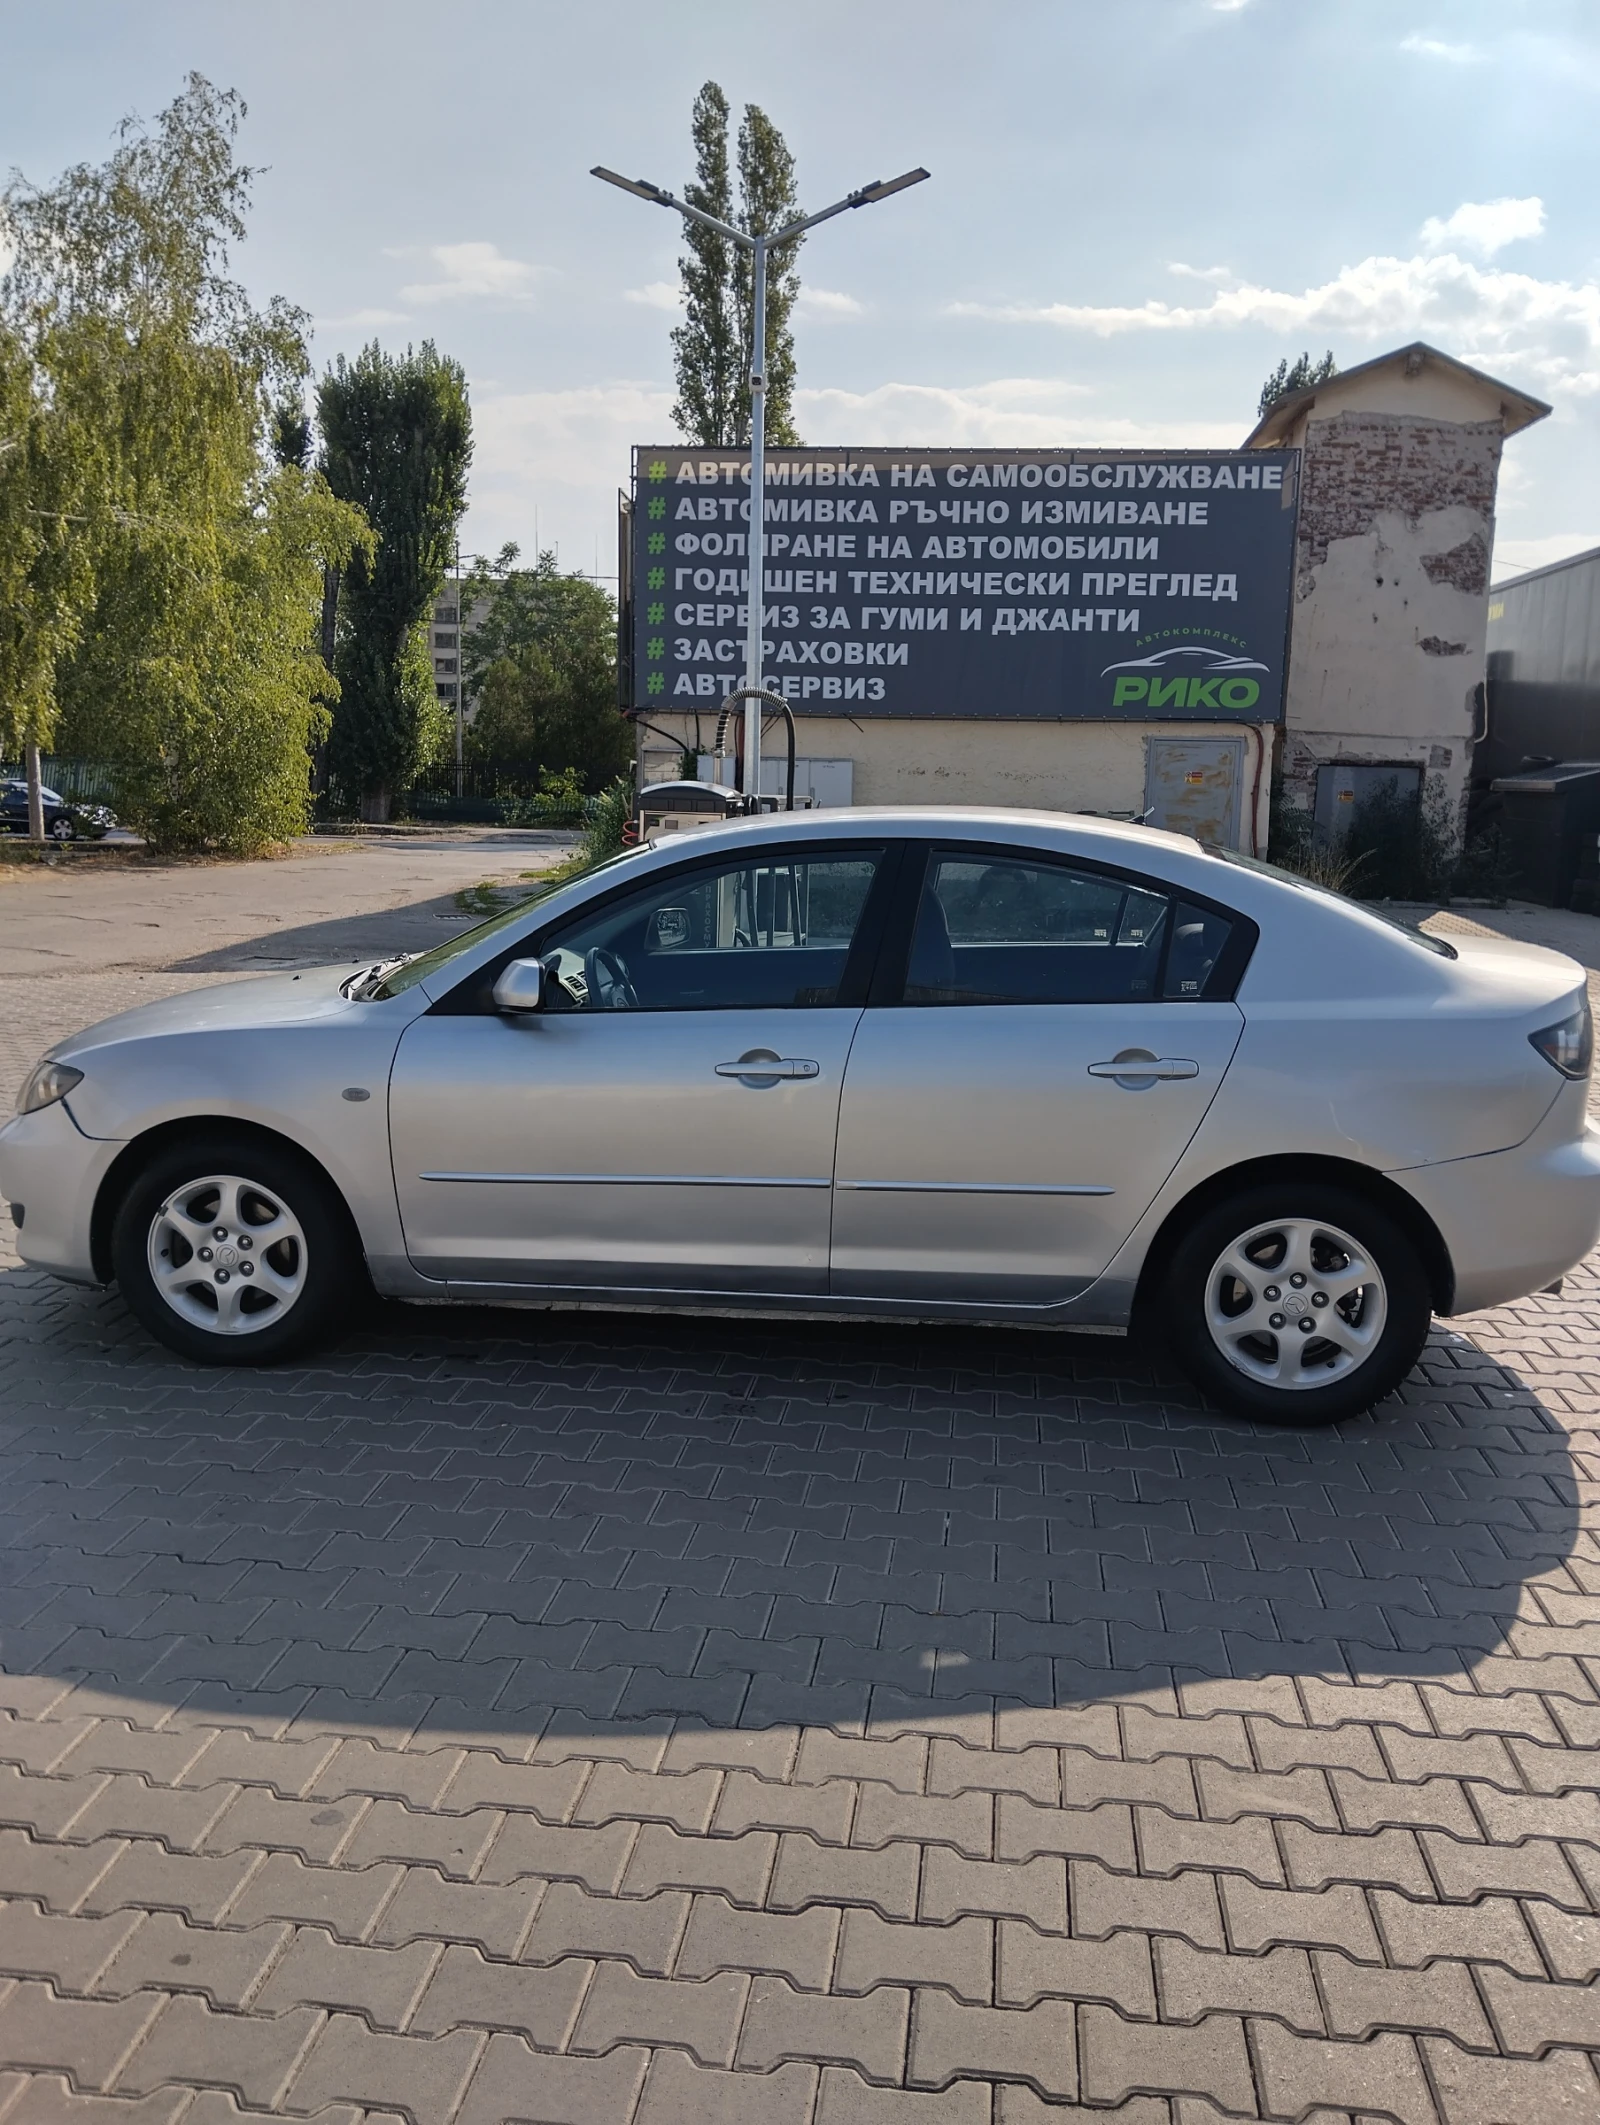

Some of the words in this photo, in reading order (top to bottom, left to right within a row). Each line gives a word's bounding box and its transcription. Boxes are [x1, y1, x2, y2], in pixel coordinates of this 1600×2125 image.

[891, 464, 936, 486] НА
[947, 464, 1282, 489] САМООБСЛУЖВАНЕ
[890, 501, 1009, 523] РЪЧНО
[1022, 501, 1208, 524] ИЗМИВАНЕ
[868, 536, 912, 558] НА
[922, 536, 1158, 559] АВТОМОБИЛИ
[848, 571, 1069, 595] ТЕХНИЧЕСКИ
[1082, 573, 1237, 601] ПРЕГЛЕД
[810, 606, 850, 629] ЗА
[862, 607, 948, 630] ГУМИ
[961, 608, 981, 630] И
[992, 609, 1139, 635] ДЖАНТИ
[1136, 627, 1247, 648] АВТОКОМПЛЕКС
[1113, 676, 1260, 708] РИКО
